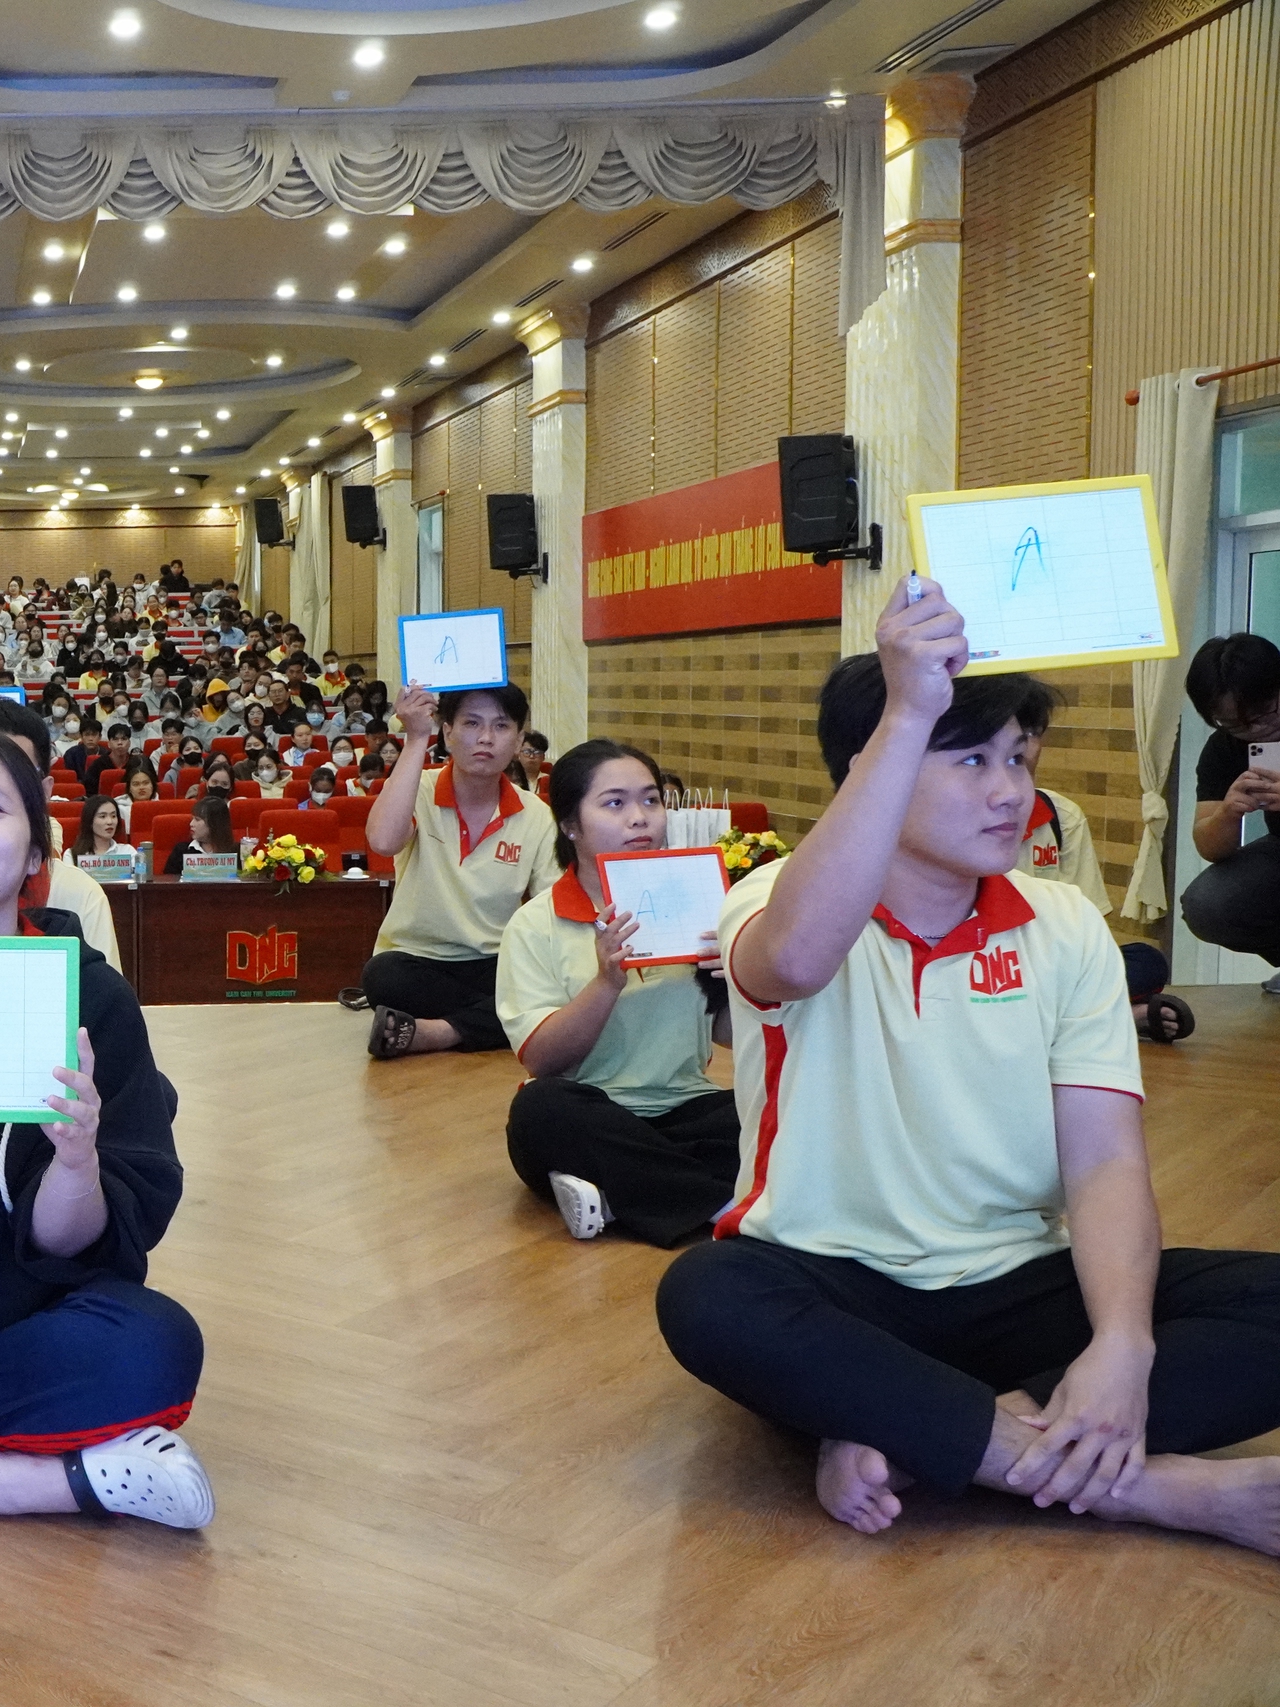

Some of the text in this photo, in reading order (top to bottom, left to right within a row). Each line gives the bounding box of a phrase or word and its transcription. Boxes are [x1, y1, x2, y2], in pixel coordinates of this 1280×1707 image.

[1011, 526, 1048, 592] A
[434, 635, 459, 665] A
[494, 840, 522, 863] DNC
[1032, 842, 1058, 867] DNC
[226, 924, 298, 985] DNC
[970, 945, 1024, 996] DNC
